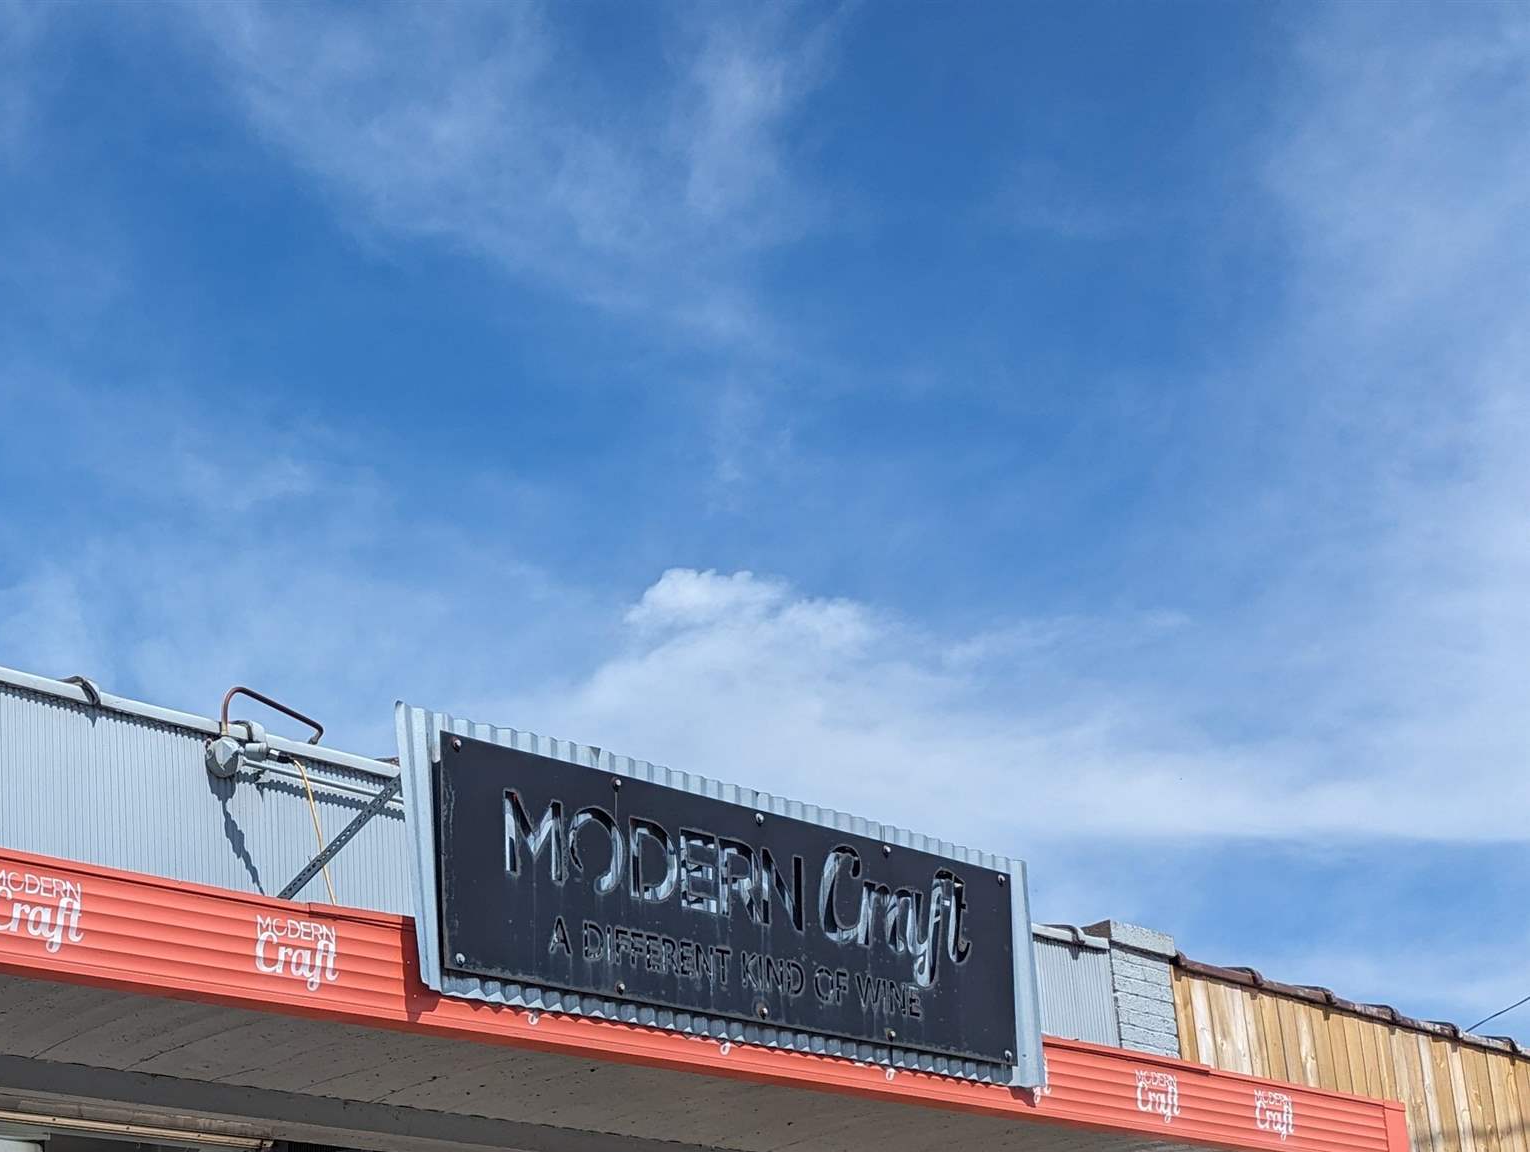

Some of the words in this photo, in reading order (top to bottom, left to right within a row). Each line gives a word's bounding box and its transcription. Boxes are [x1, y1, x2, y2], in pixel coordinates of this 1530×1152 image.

[503, 788, 806, 936] MODERN
[818, 843, 972, 989] Craft
[256, 914, 337, 944] MODERN
[255, 931, 340, 992] Craft
[549, 915, 573, 957] A
[582, 920, 732, 985] DIFFERENT
[740, 950, 806, 998] KIND
[813, 966, 849, 1003] OF
[854, 972, 924, 1019] WINE
[1134, 1069, 1178, 1088] MODERN
[1253, 1089, 1294, 1106] MODERN
[1135, 1081, 1181, 1123] Craft
[1255, 1100, 1295, 1141] Craft
